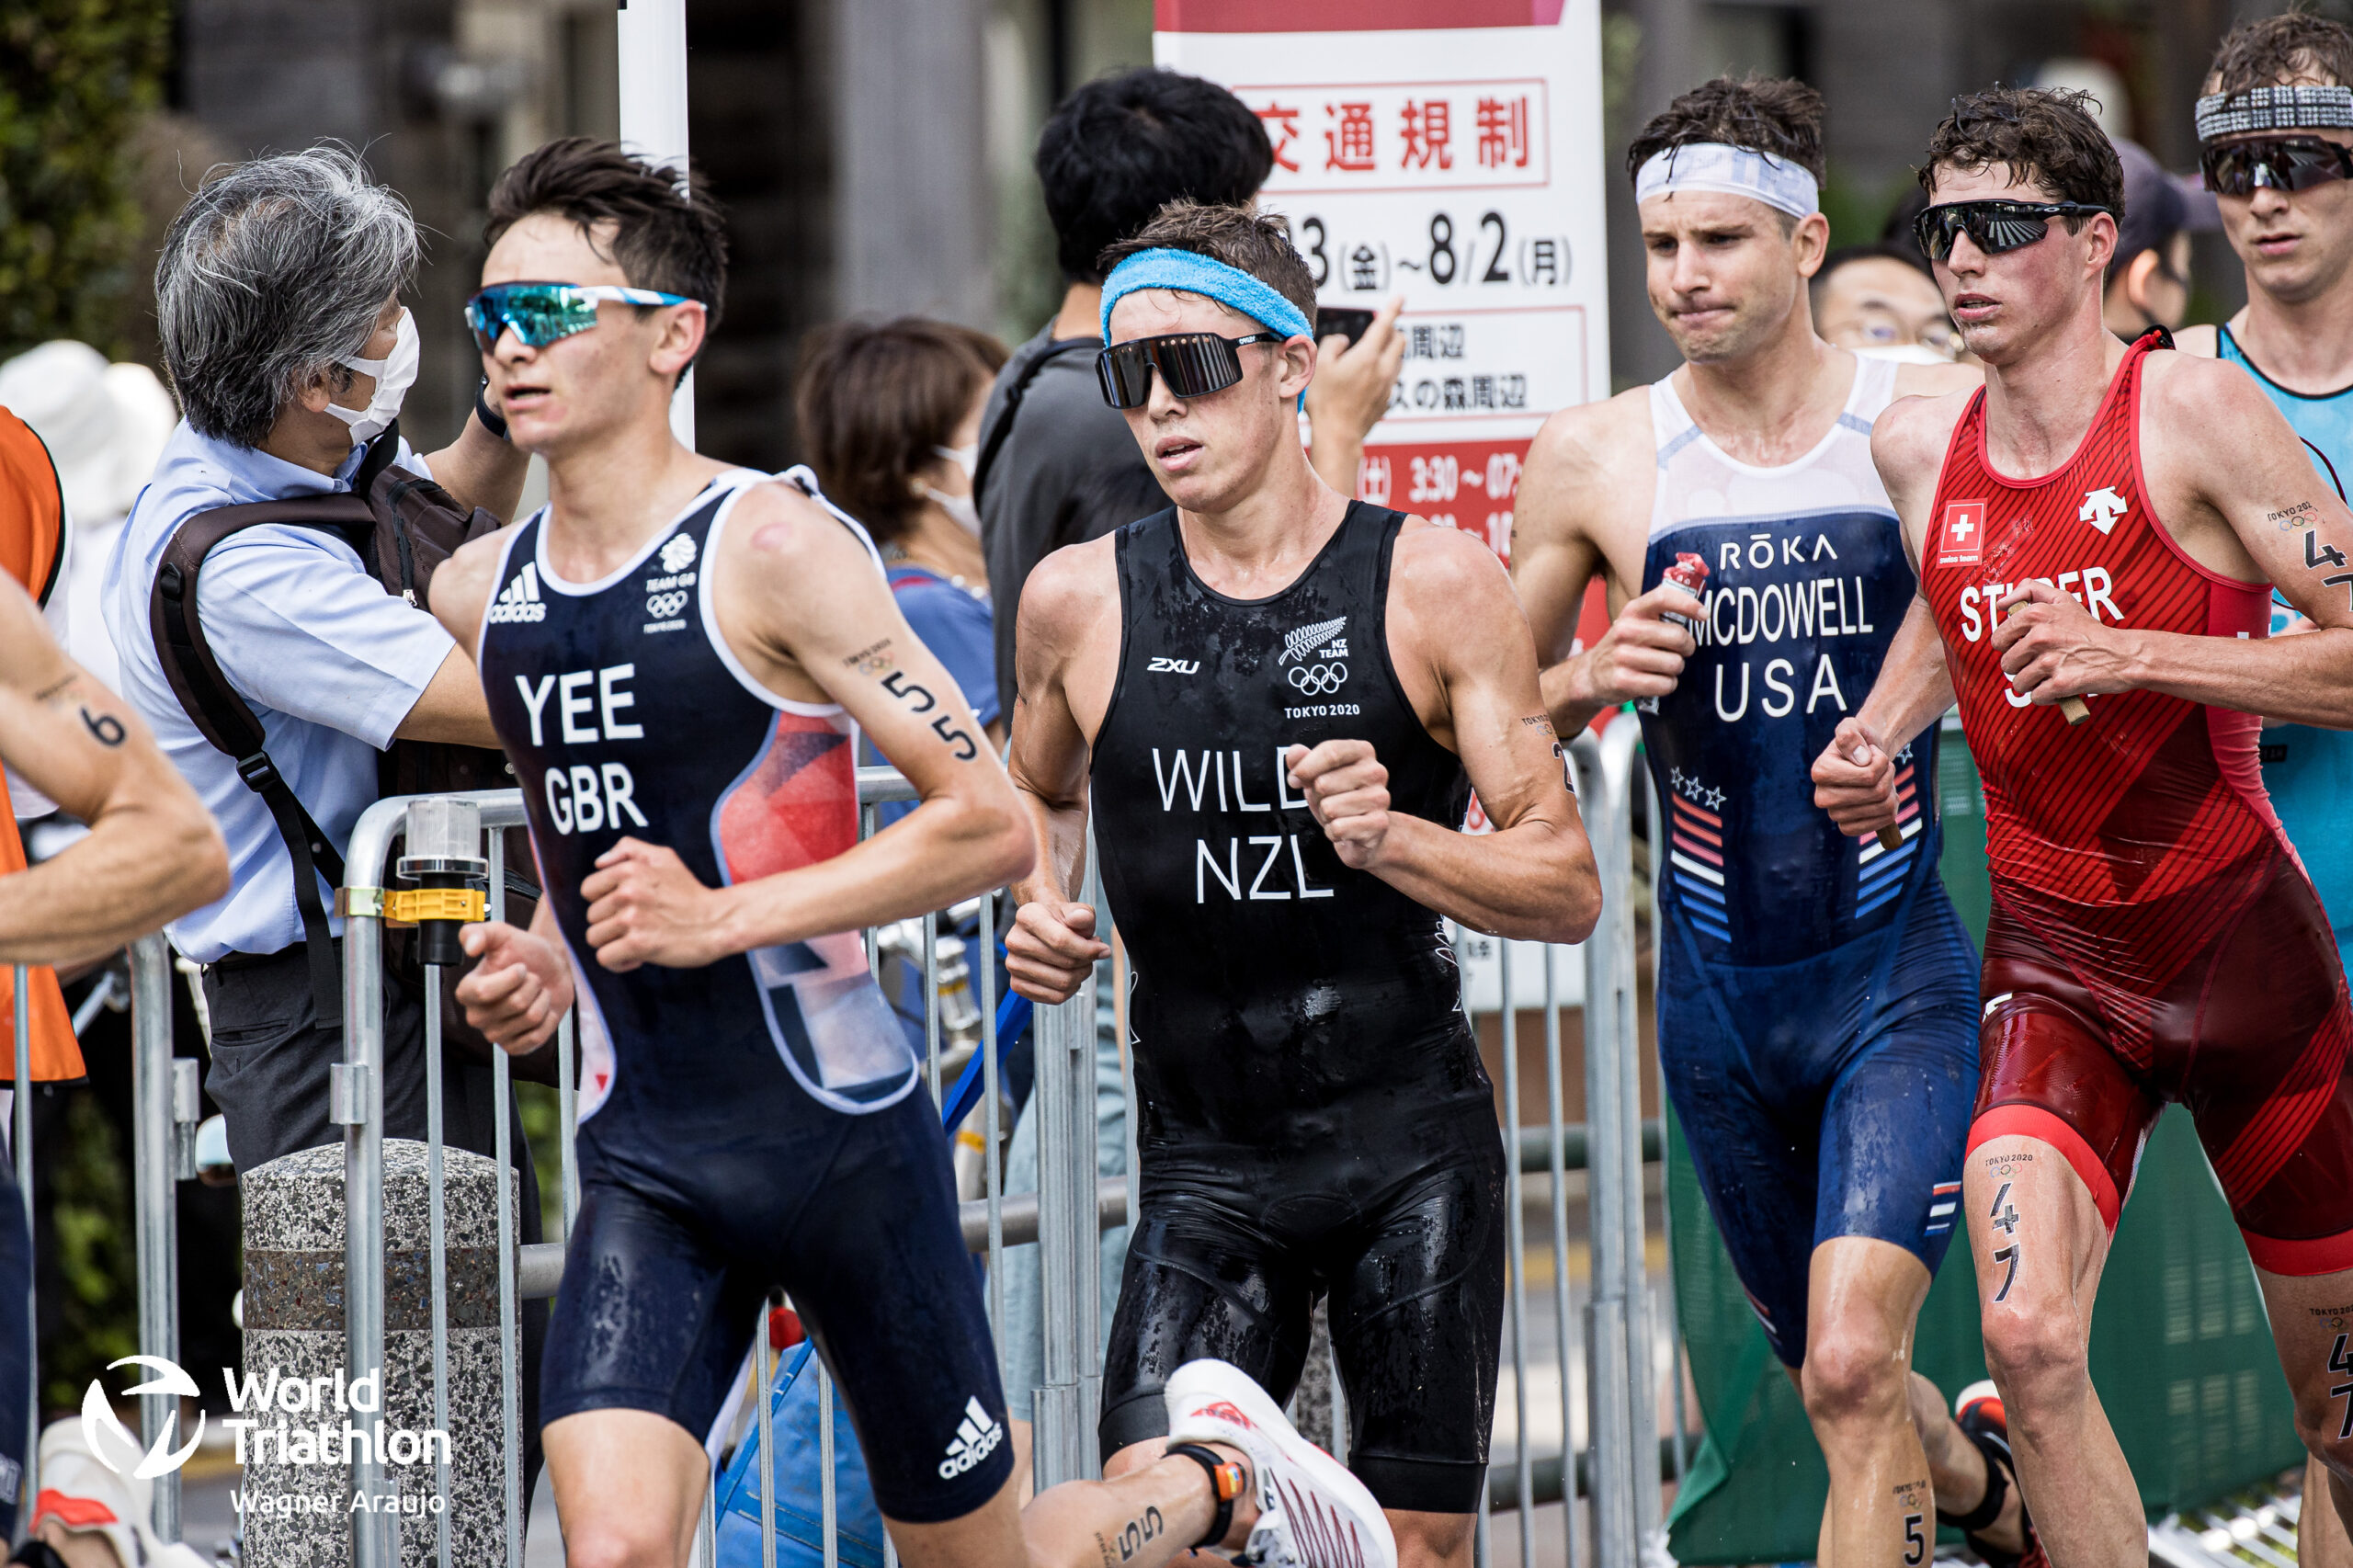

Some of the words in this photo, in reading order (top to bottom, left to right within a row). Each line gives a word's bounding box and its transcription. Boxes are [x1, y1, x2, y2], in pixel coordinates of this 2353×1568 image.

[1256, 96, 1530, 173] 交通規制
[1401, 324, 1464, 359] 周辺
[1939, 556, 1959, 564] swiss
[1960, 554, 1979, 562] team
[488, 601, 547, 624] adidas
[1688, 576, 1873, 646] MCDOWELL
[1146, 657, 1199, 674] 2XU
[1319, 648, 1348, 658] TEAM
[1332, 638, 1347, 648] NZ
[515, 663, 644, 746] YEE
[1284, 705, 1326, 719] TOKYO
[1330, 704, 1360, 716] 2020
[1715, 653, 1847, 722] USA
[79, 707, 127, 747] 6
[881, 671, 977, 760] 55
[545, 762, 649, 835] GBR
[1197, 835, 1334, 903] NZL
[1990, 1182, 2020, 1302] 47
[938, 1422, 1003, 1480] adidas
[1904, 1515, 1925, 1566] 5
